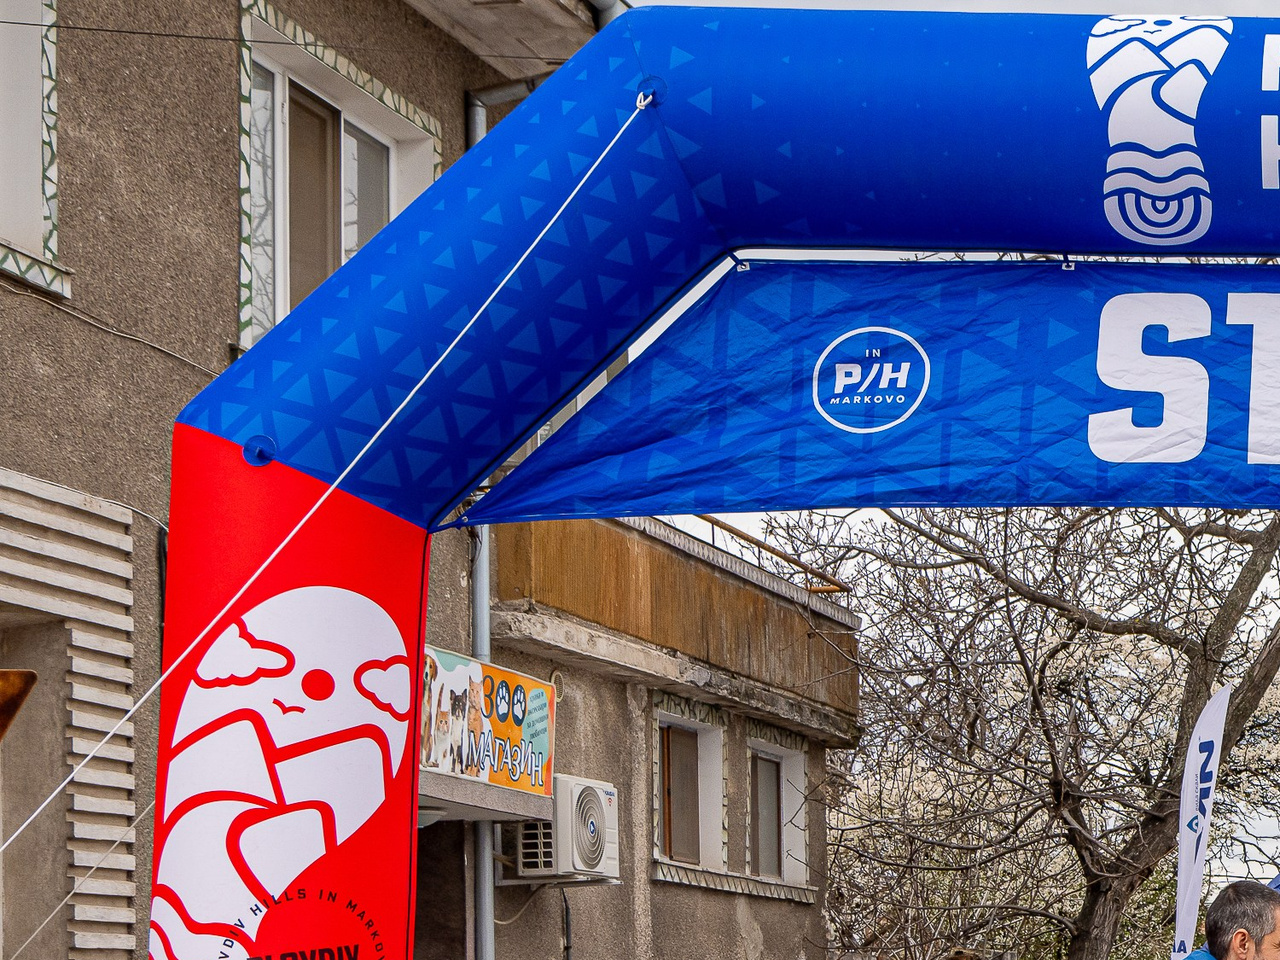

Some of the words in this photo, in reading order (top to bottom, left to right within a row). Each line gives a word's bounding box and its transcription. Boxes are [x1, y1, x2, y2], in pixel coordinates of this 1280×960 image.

[865, 349, 881, 358] IN
[834, 362, 911, 394] P/H
[830, 395, 905, 405] MARKOVO
[468, 729, 544, 787] МАГАЗИН
[250, 888, 306, 916] HILLS
[319, 889, 337, 902] IN
